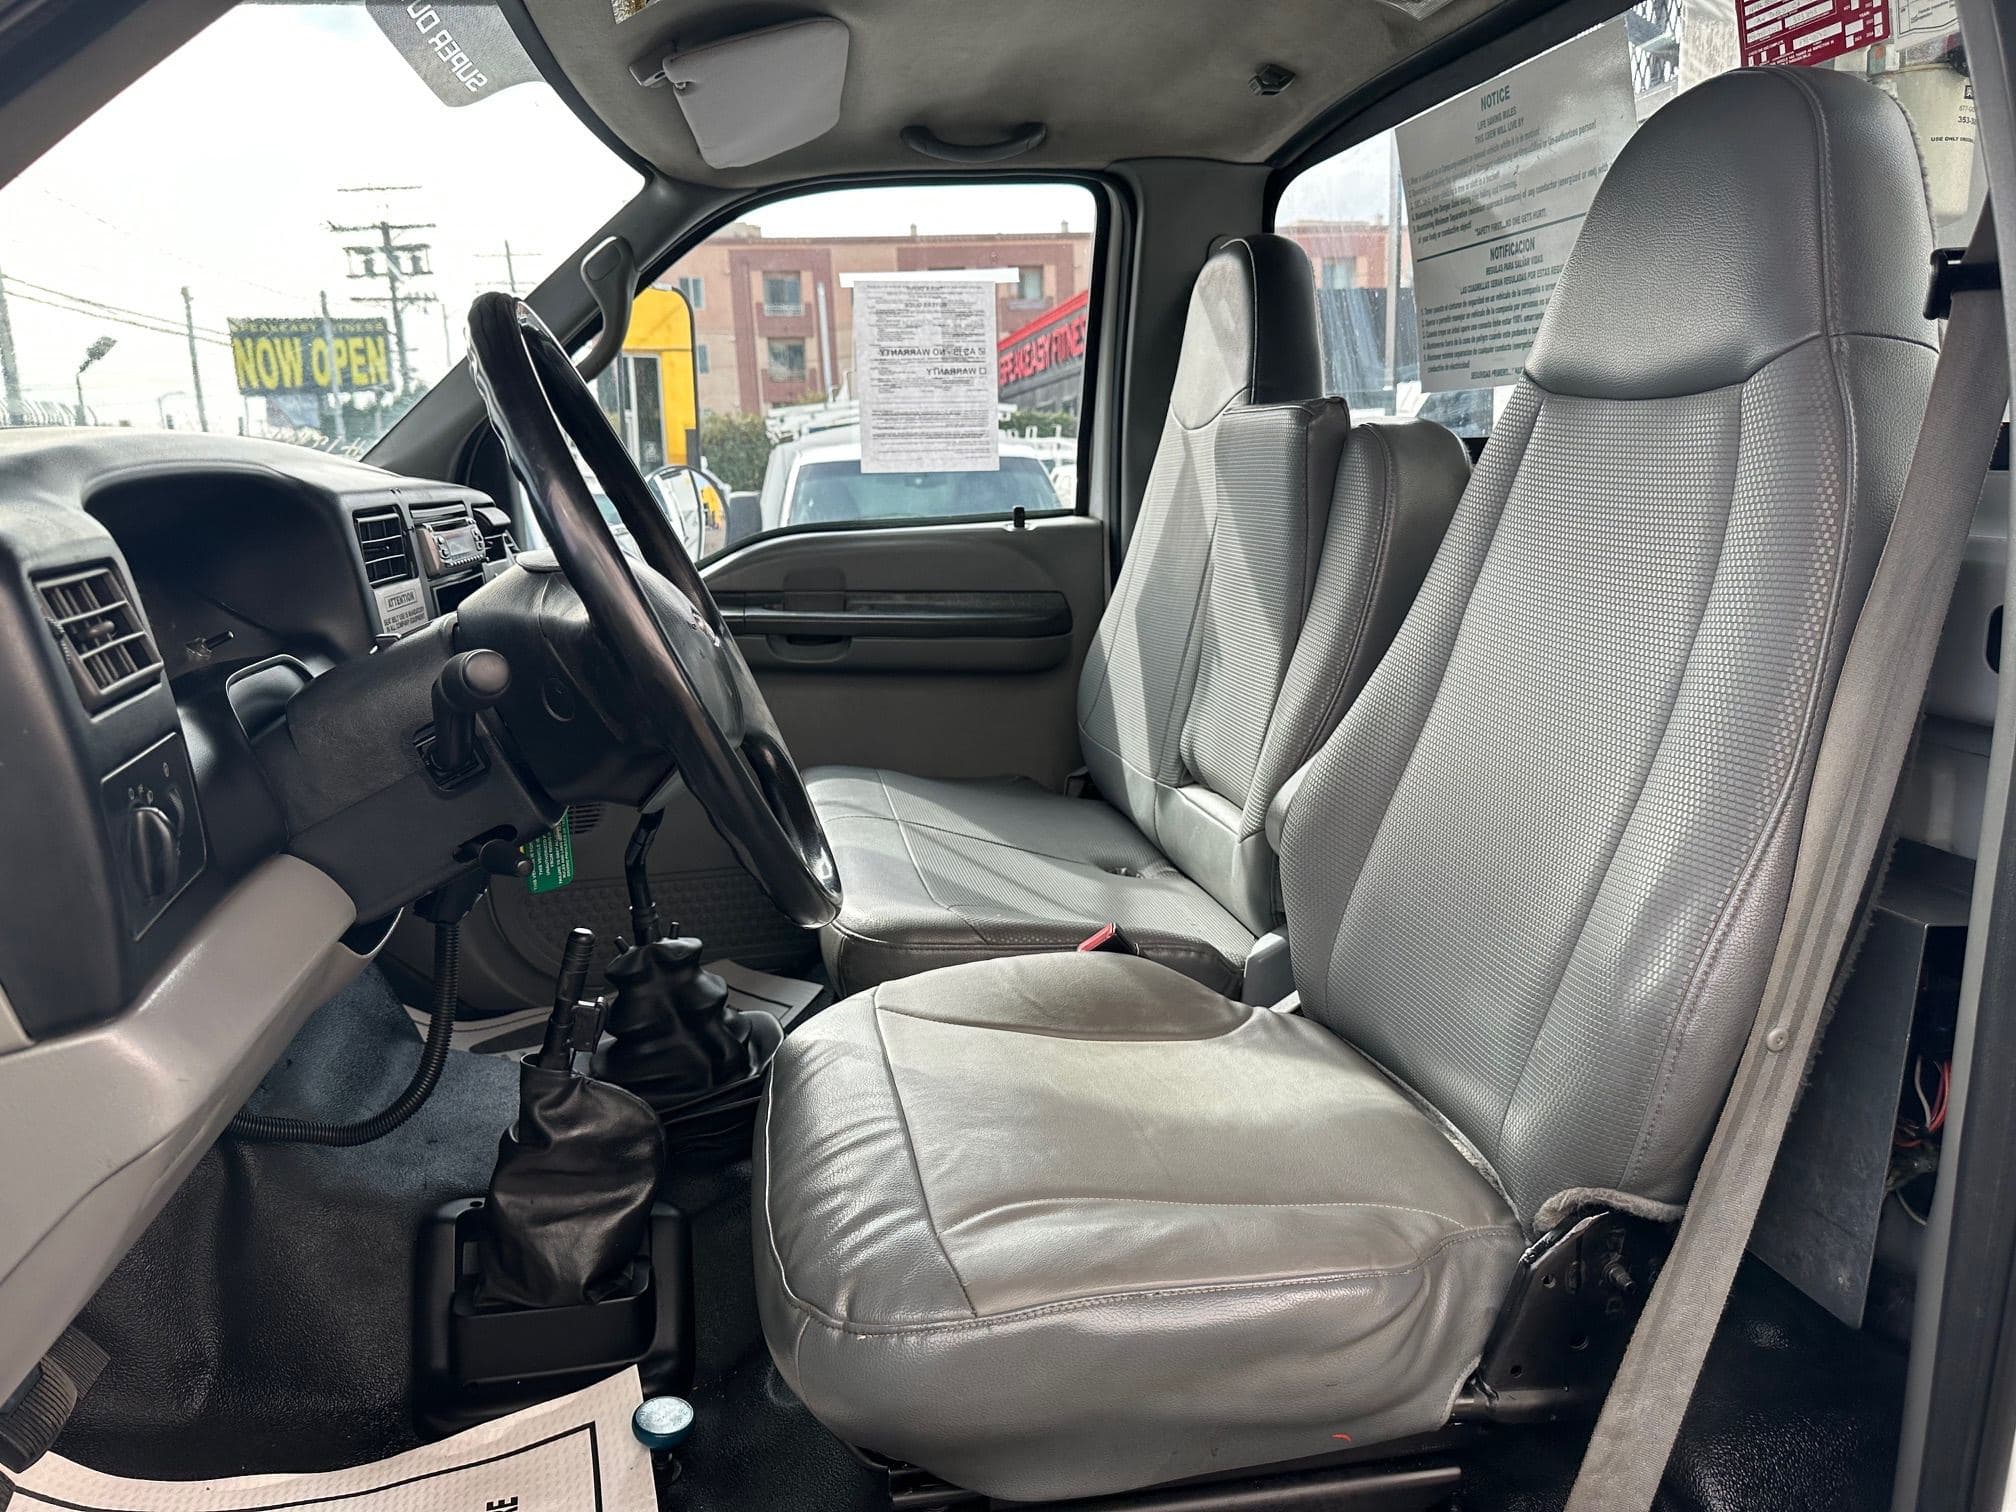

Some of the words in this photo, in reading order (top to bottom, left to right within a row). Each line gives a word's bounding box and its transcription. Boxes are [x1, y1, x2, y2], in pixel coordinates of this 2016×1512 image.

[1480, 85, 1510, 111] NOTICE
[1502, 106, 1517, 120] RULES
[1490, 237, 1535, 260] NOTIFICACION
[233, 336, 304, 390] NOW
[311, 335, 389, 387] OPEN
[388, 592, 414, 608] ATTENTION
